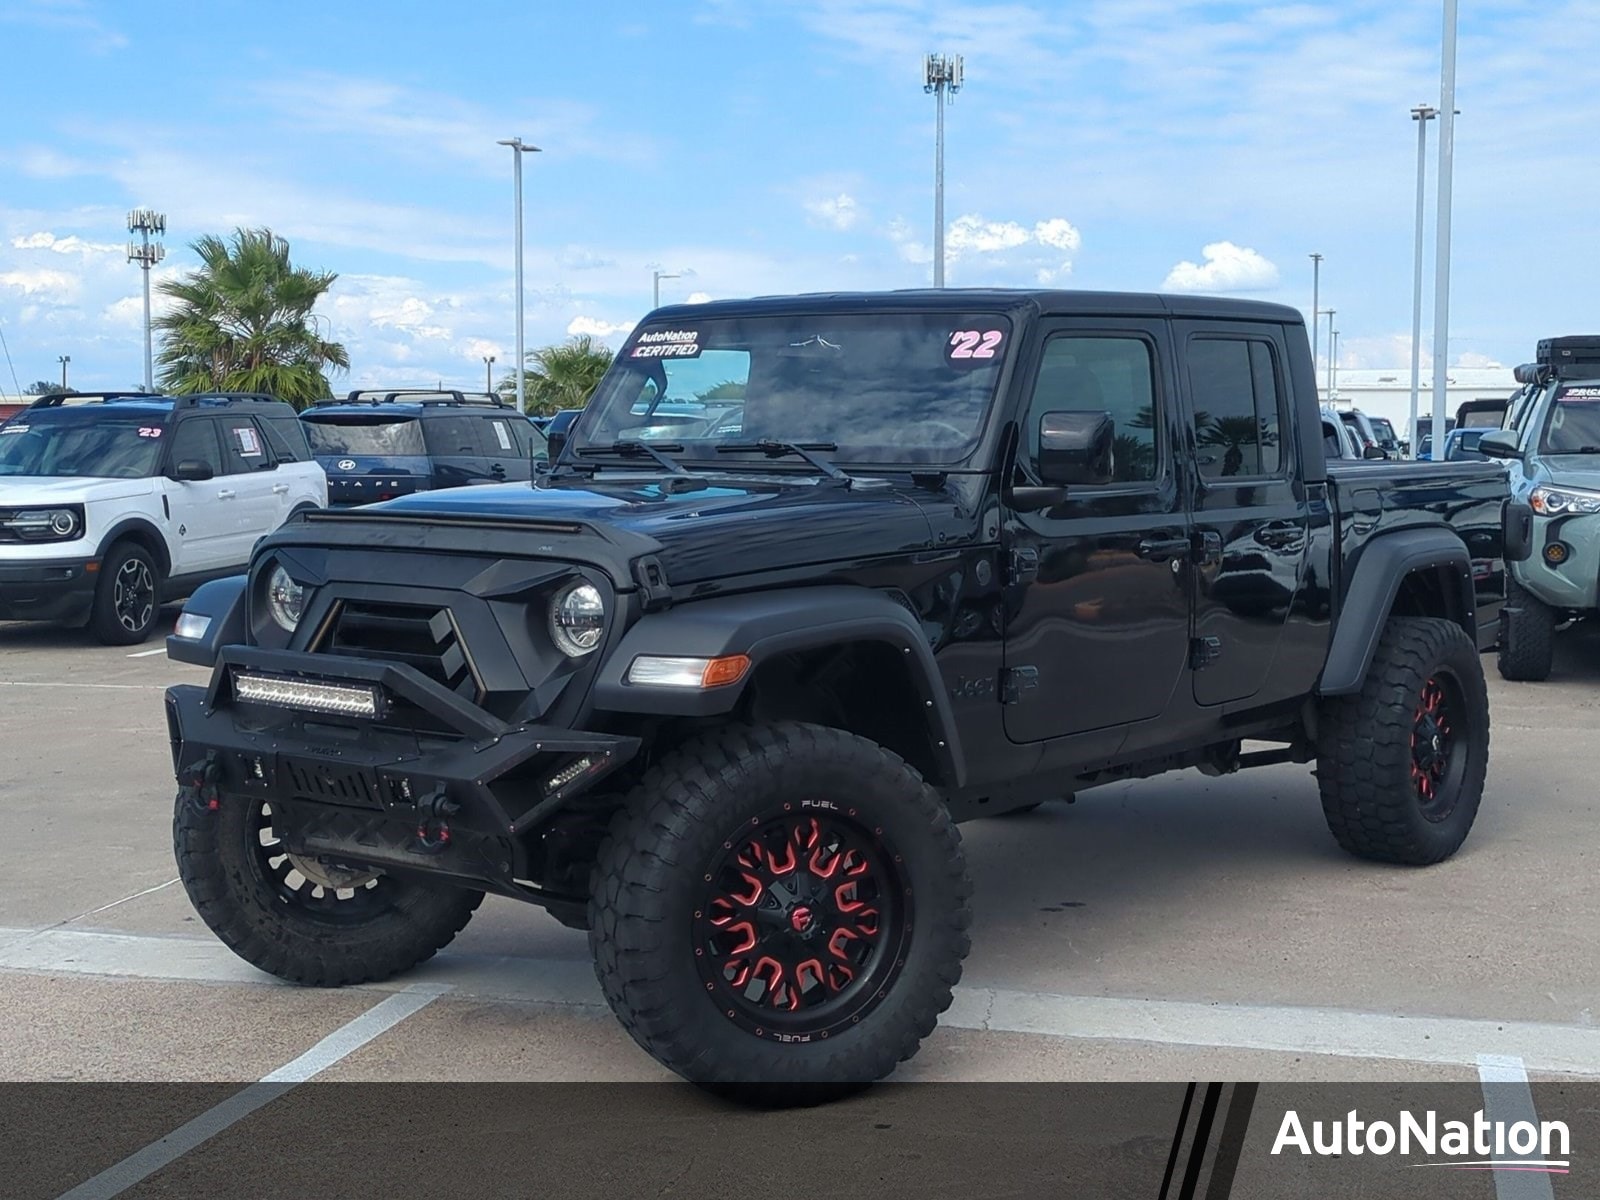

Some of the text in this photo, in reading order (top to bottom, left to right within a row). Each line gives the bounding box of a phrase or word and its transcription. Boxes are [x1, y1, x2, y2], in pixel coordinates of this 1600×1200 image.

[637, 330, 698, 343] AutoNation
[636, 343, 699, 357] CERTIFIED
[952, 675, 994, 697] Jeep
[801, 799, 838, 810] FUEL
[773, 1032, 810, 1043] FUEL
